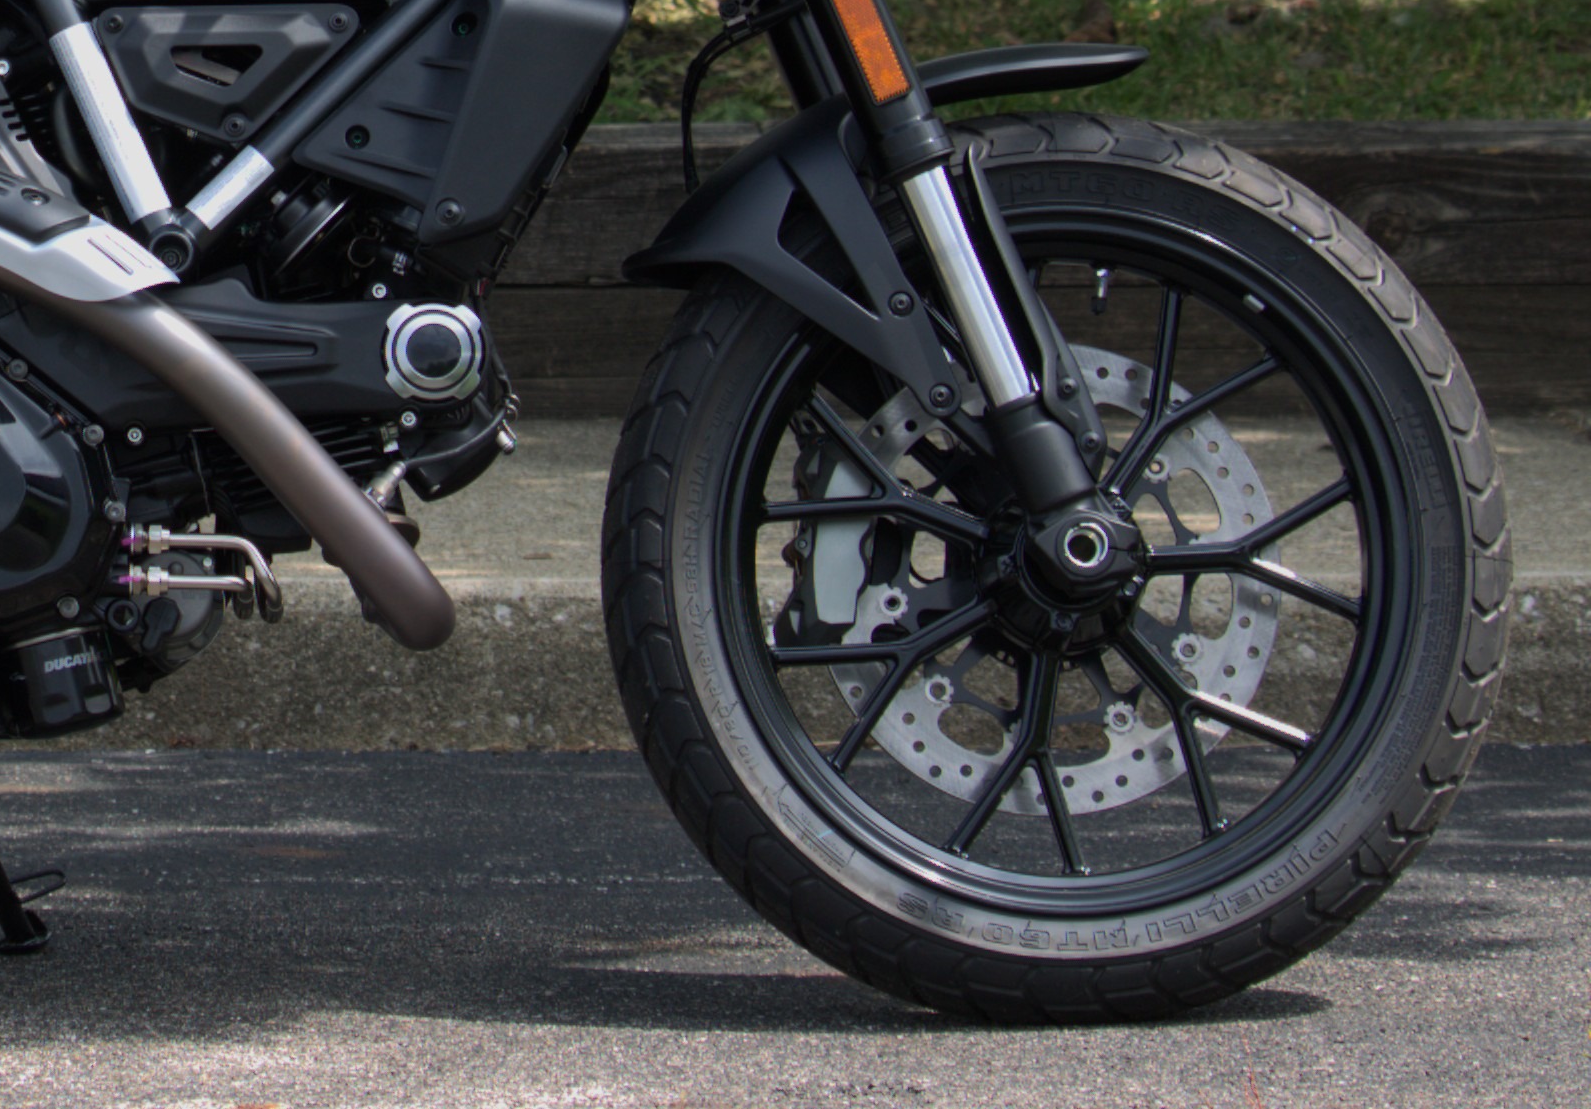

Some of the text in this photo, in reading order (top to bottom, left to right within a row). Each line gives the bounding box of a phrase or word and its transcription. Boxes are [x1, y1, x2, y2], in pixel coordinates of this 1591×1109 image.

[43, 653, 94, 673] DUCATI
[894, 831, 1340, 951] PIRELLI MT60 RS
